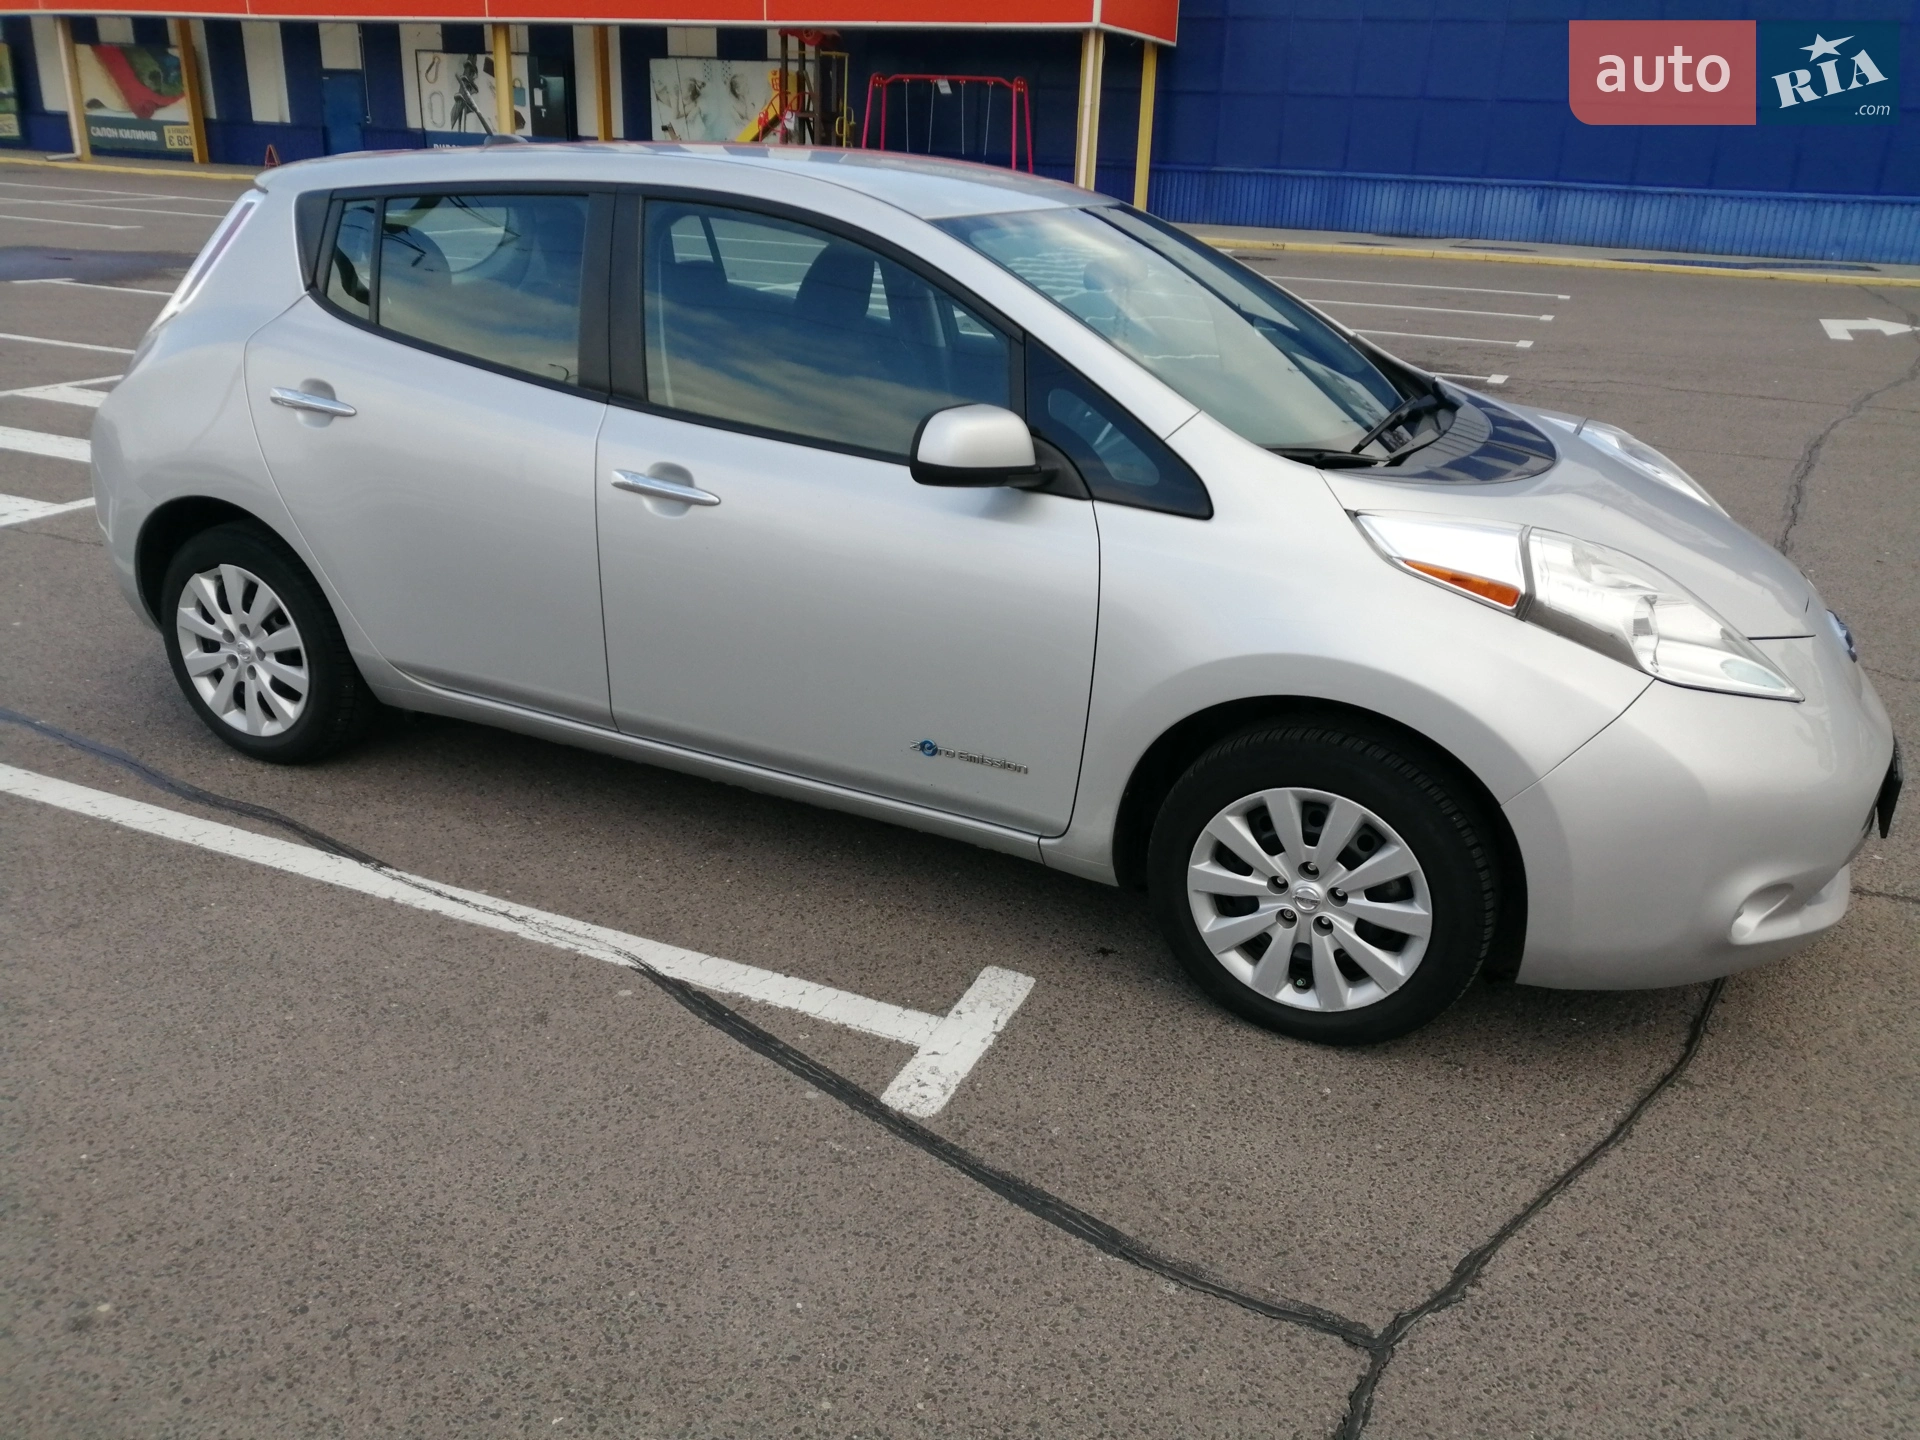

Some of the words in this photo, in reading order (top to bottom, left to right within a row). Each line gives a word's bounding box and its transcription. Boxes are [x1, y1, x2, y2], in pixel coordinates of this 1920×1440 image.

[90, 126, 118, 138] САЛОН
[119, 128, 158, 141] КИЛИМІВ
[909, 739, 955, 759] Zero
[957, 749, 1029, 775] Emission
